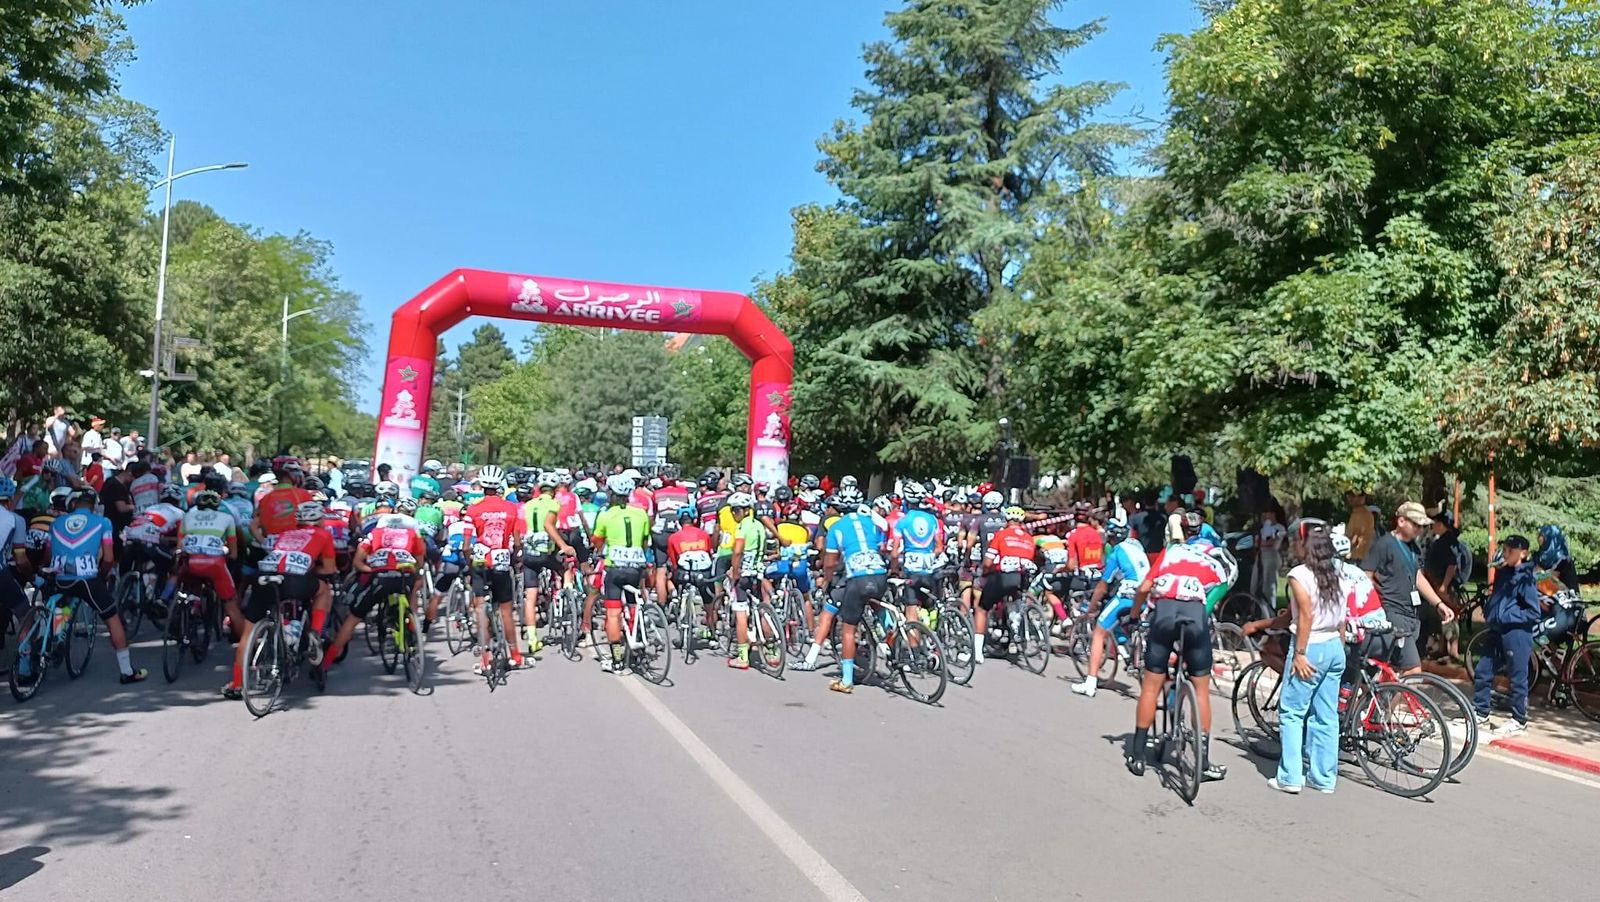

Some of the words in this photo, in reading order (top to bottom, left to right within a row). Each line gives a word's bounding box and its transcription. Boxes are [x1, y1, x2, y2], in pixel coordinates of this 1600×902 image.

[553, 301, 660, 324] ARRIVEE
[208, 537, 223, 547] 29
[80, 556, 95, 570] 31
[289, 553, 310, 565] 568
[1183, 578, 1200, 593] 45
